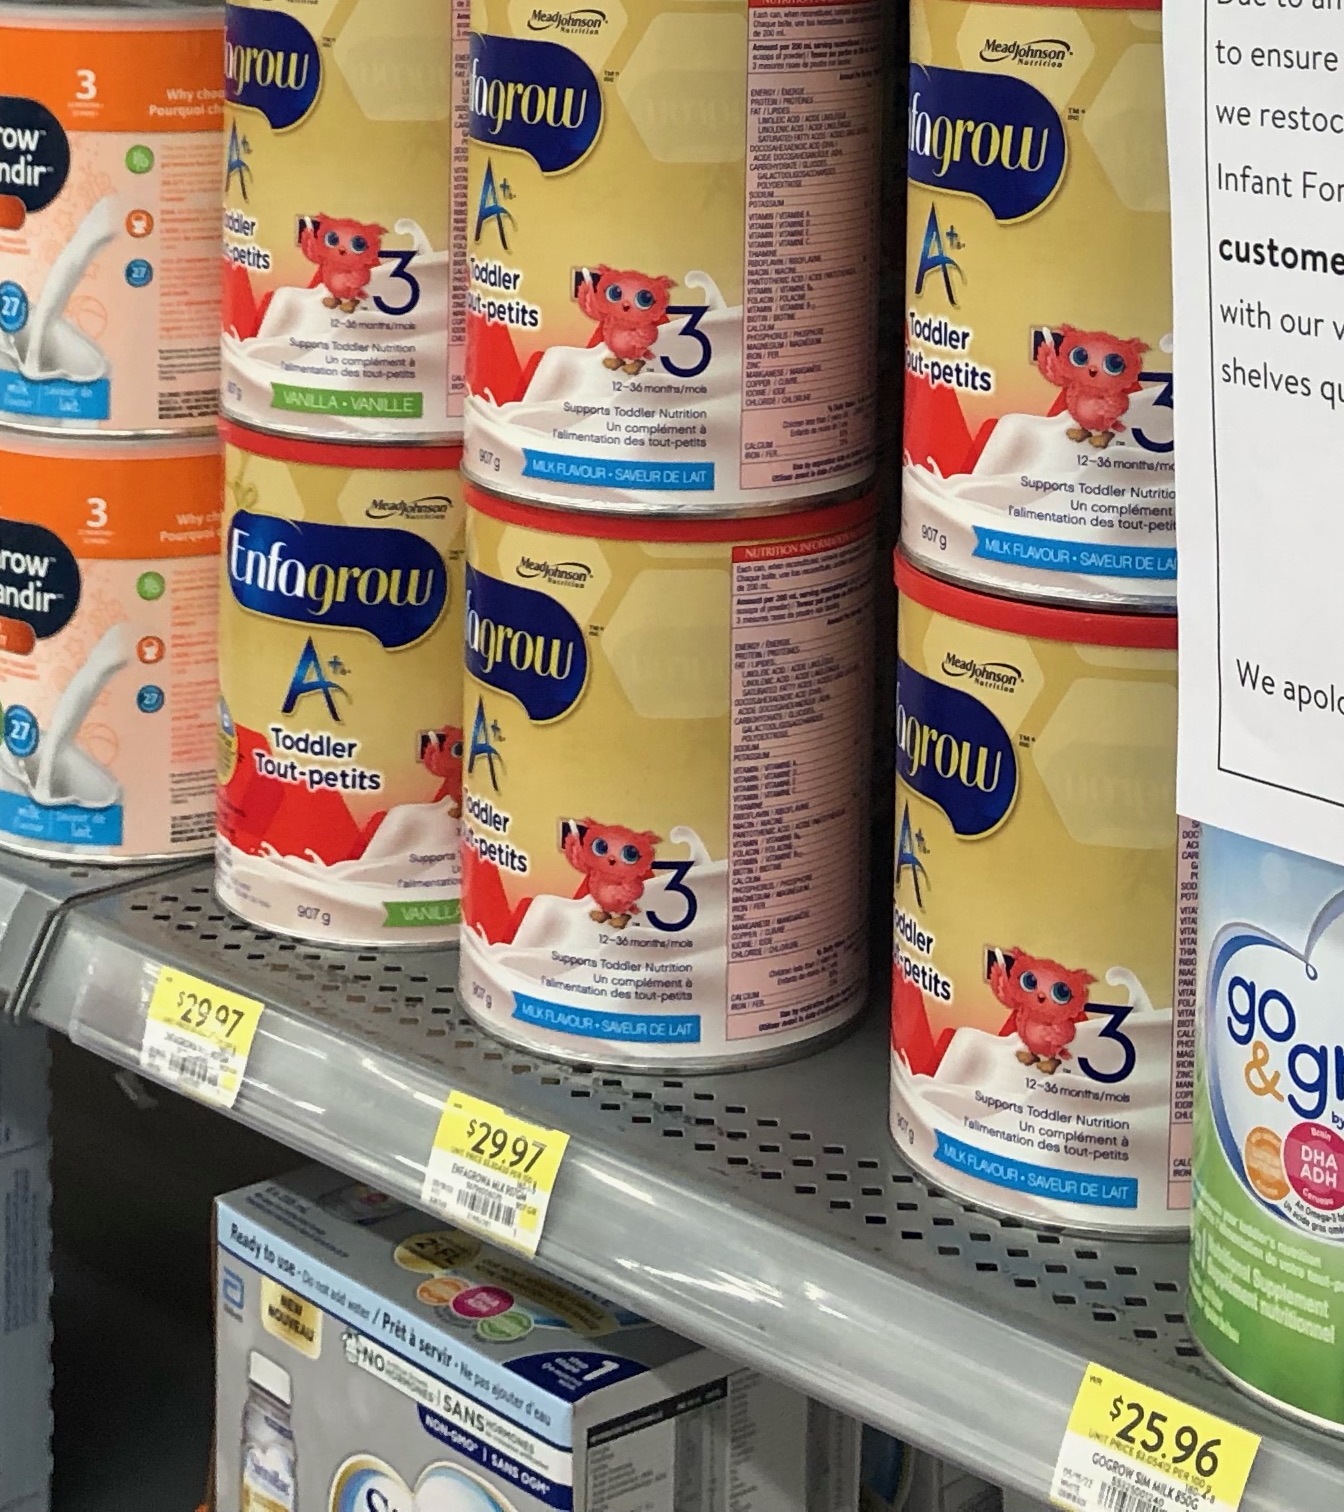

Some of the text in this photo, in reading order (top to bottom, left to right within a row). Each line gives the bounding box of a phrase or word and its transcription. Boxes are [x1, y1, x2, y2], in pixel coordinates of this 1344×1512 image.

[1214, 39, 1243, 66] to
[1250, 47, 1339, 72] ensure
[75, 69, 97, 100] 3
[1215, 104, 1252, 127] we
[1217, 162, 1293, 199] Infant
[1219, 298, 1272, 331] with
[1279, 313, 1325, 338] our
[1221, 356, 1312, 398] shelves
[283, 388, 413, 415] VANILLA VANILLE
[563, 402, 707, 421] Supports Toddler Nutrition
[230, 528, 434, 616] Enfagrow
[1235, 658, 1276, 696] We
[272, 727, 356, 761] Toddler
[255, 752, 381, 792] Tout-petits
[1226, 975, 1295, 1045] go
[467, 1119, 547, 1173] $29.97
[1301, 1146, 1339, 1169] DHA
[1300, 1165, 1339, 1188] ADH
[1109, 1395, 1221, 1478] $25.96
